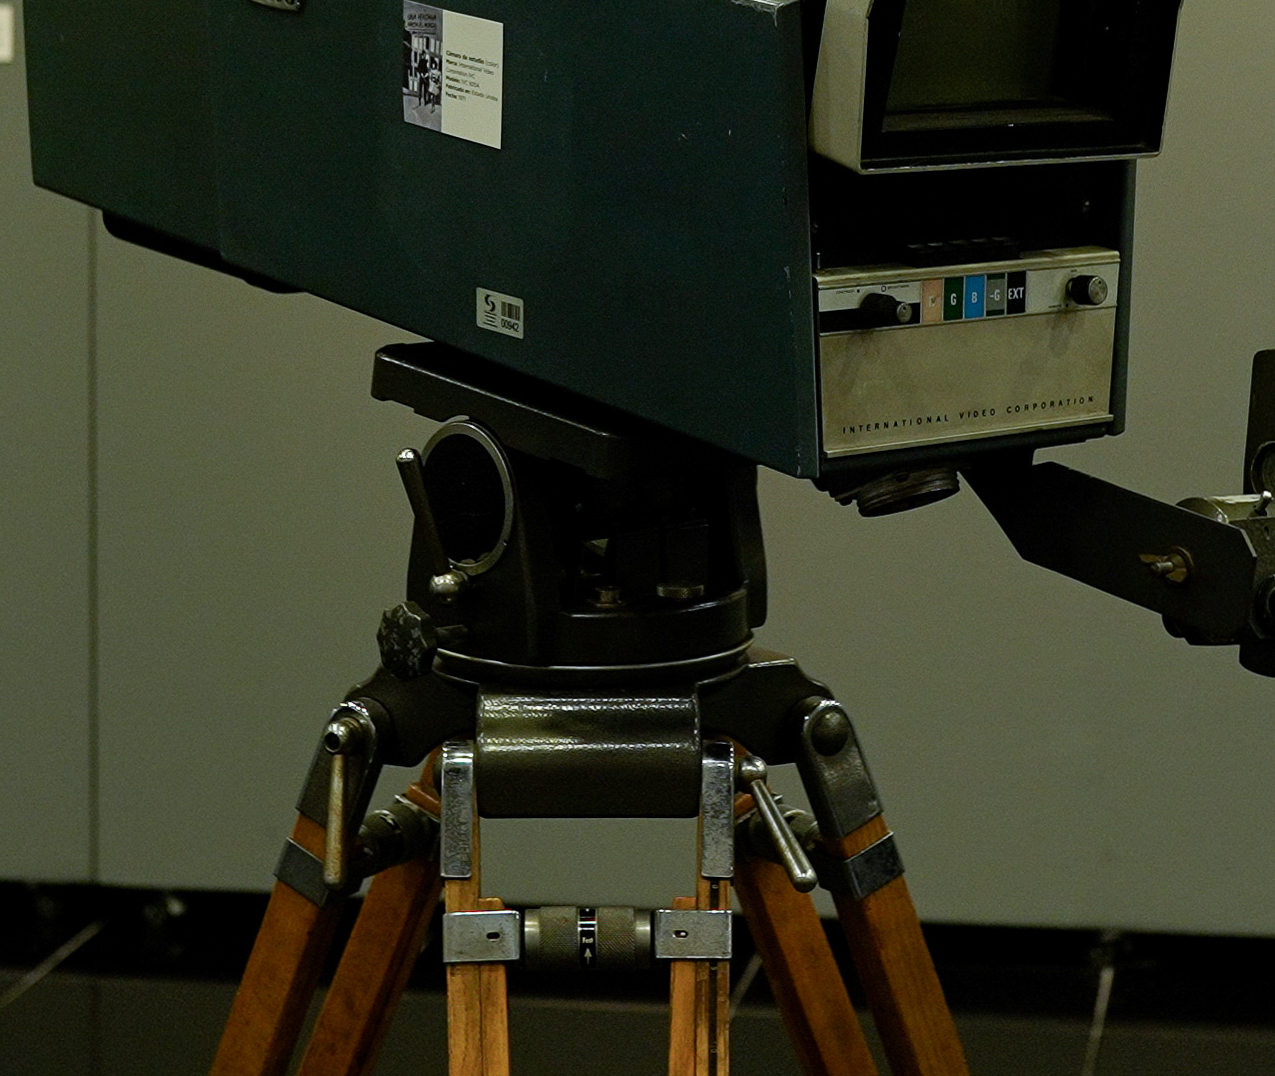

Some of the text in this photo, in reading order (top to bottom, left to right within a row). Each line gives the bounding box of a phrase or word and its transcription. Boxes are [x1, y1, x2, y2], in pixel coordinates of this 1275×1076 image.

[950, 293, 957, 306] G
[1007, 287, 1025, 300] EXT
[842, 395, 1095, 435] INTERNATIONAL VIDEO CORPORATION
